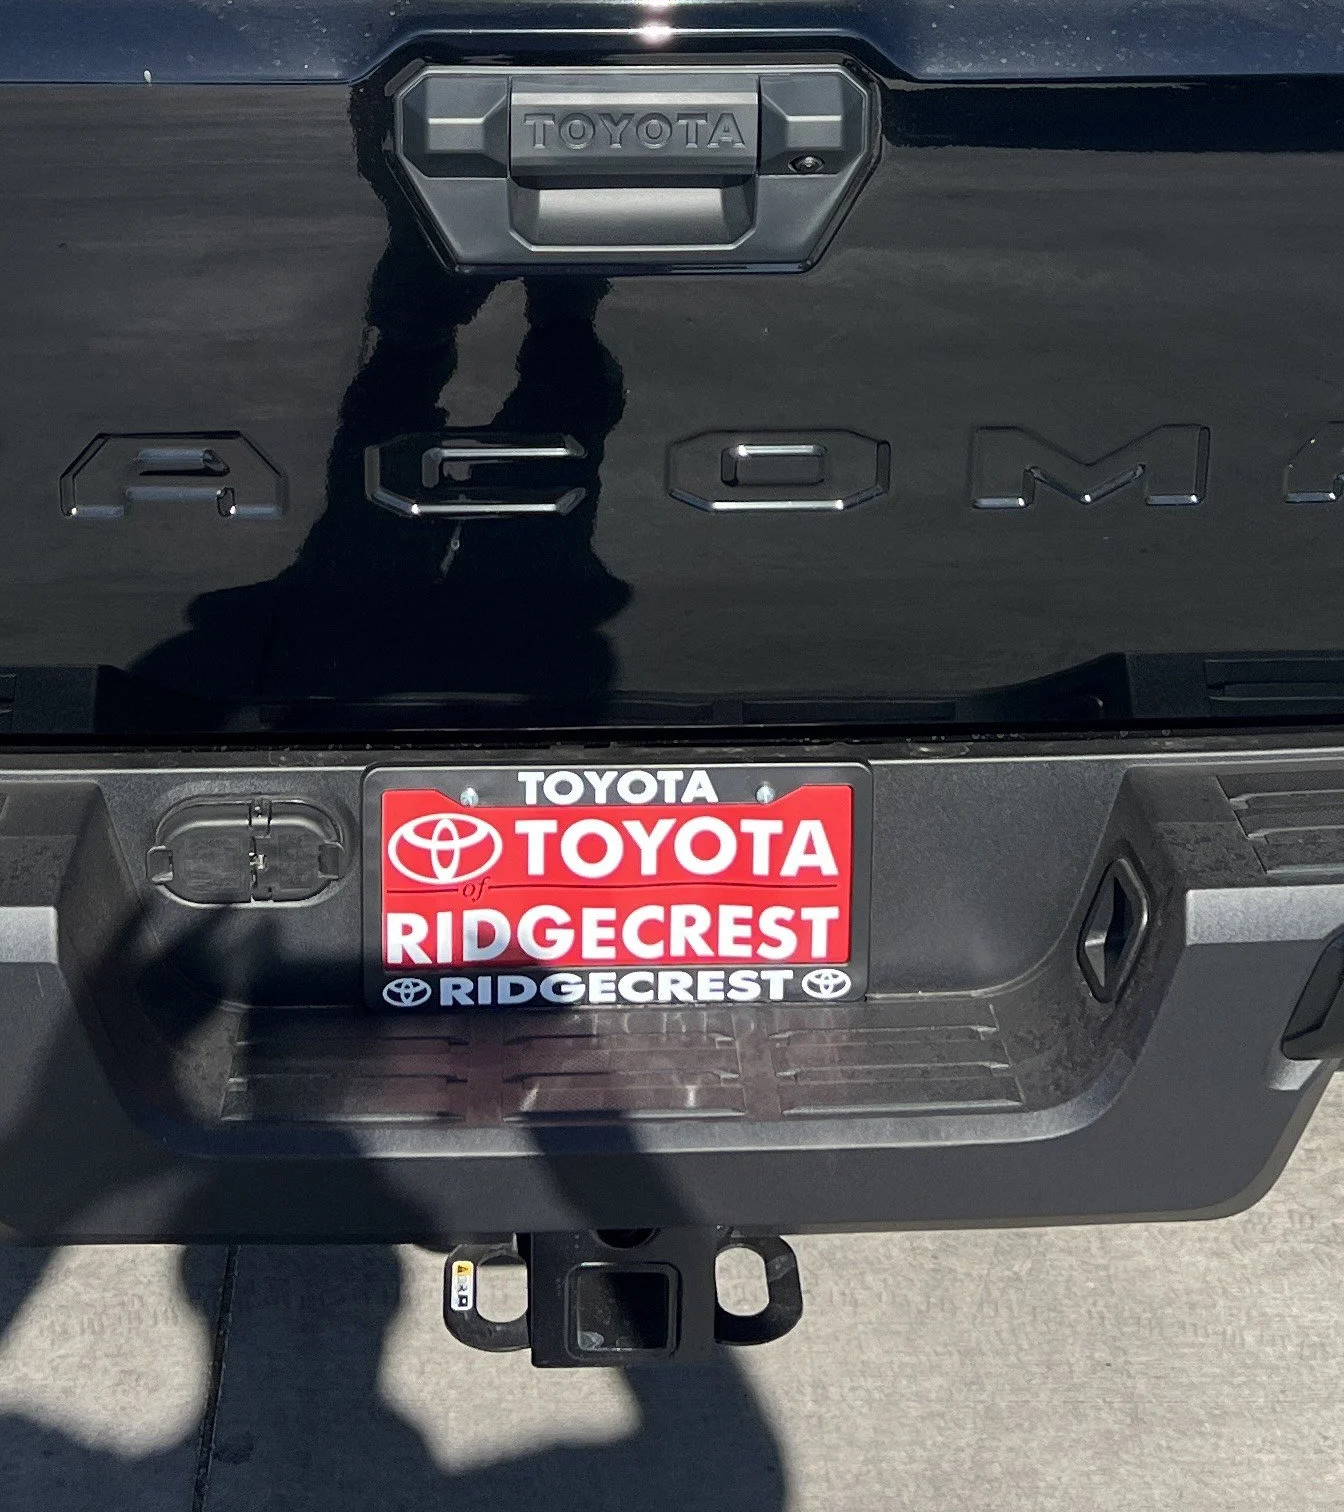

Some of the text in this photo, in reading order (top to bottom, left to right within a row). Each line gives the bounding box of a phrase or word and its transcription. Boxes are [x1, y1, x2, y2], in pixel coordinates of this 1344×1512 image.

[524, 112, 746, 150] TOYOTA
[517, 770, 718, 805] TOYOTA
[514, 815, 840, 879] TOYOTA
[461, 876, 492, 903] of
[386, 904, 840, 966] RIDGECREST
[440, 969, 794, 1007] RIDGECREST
